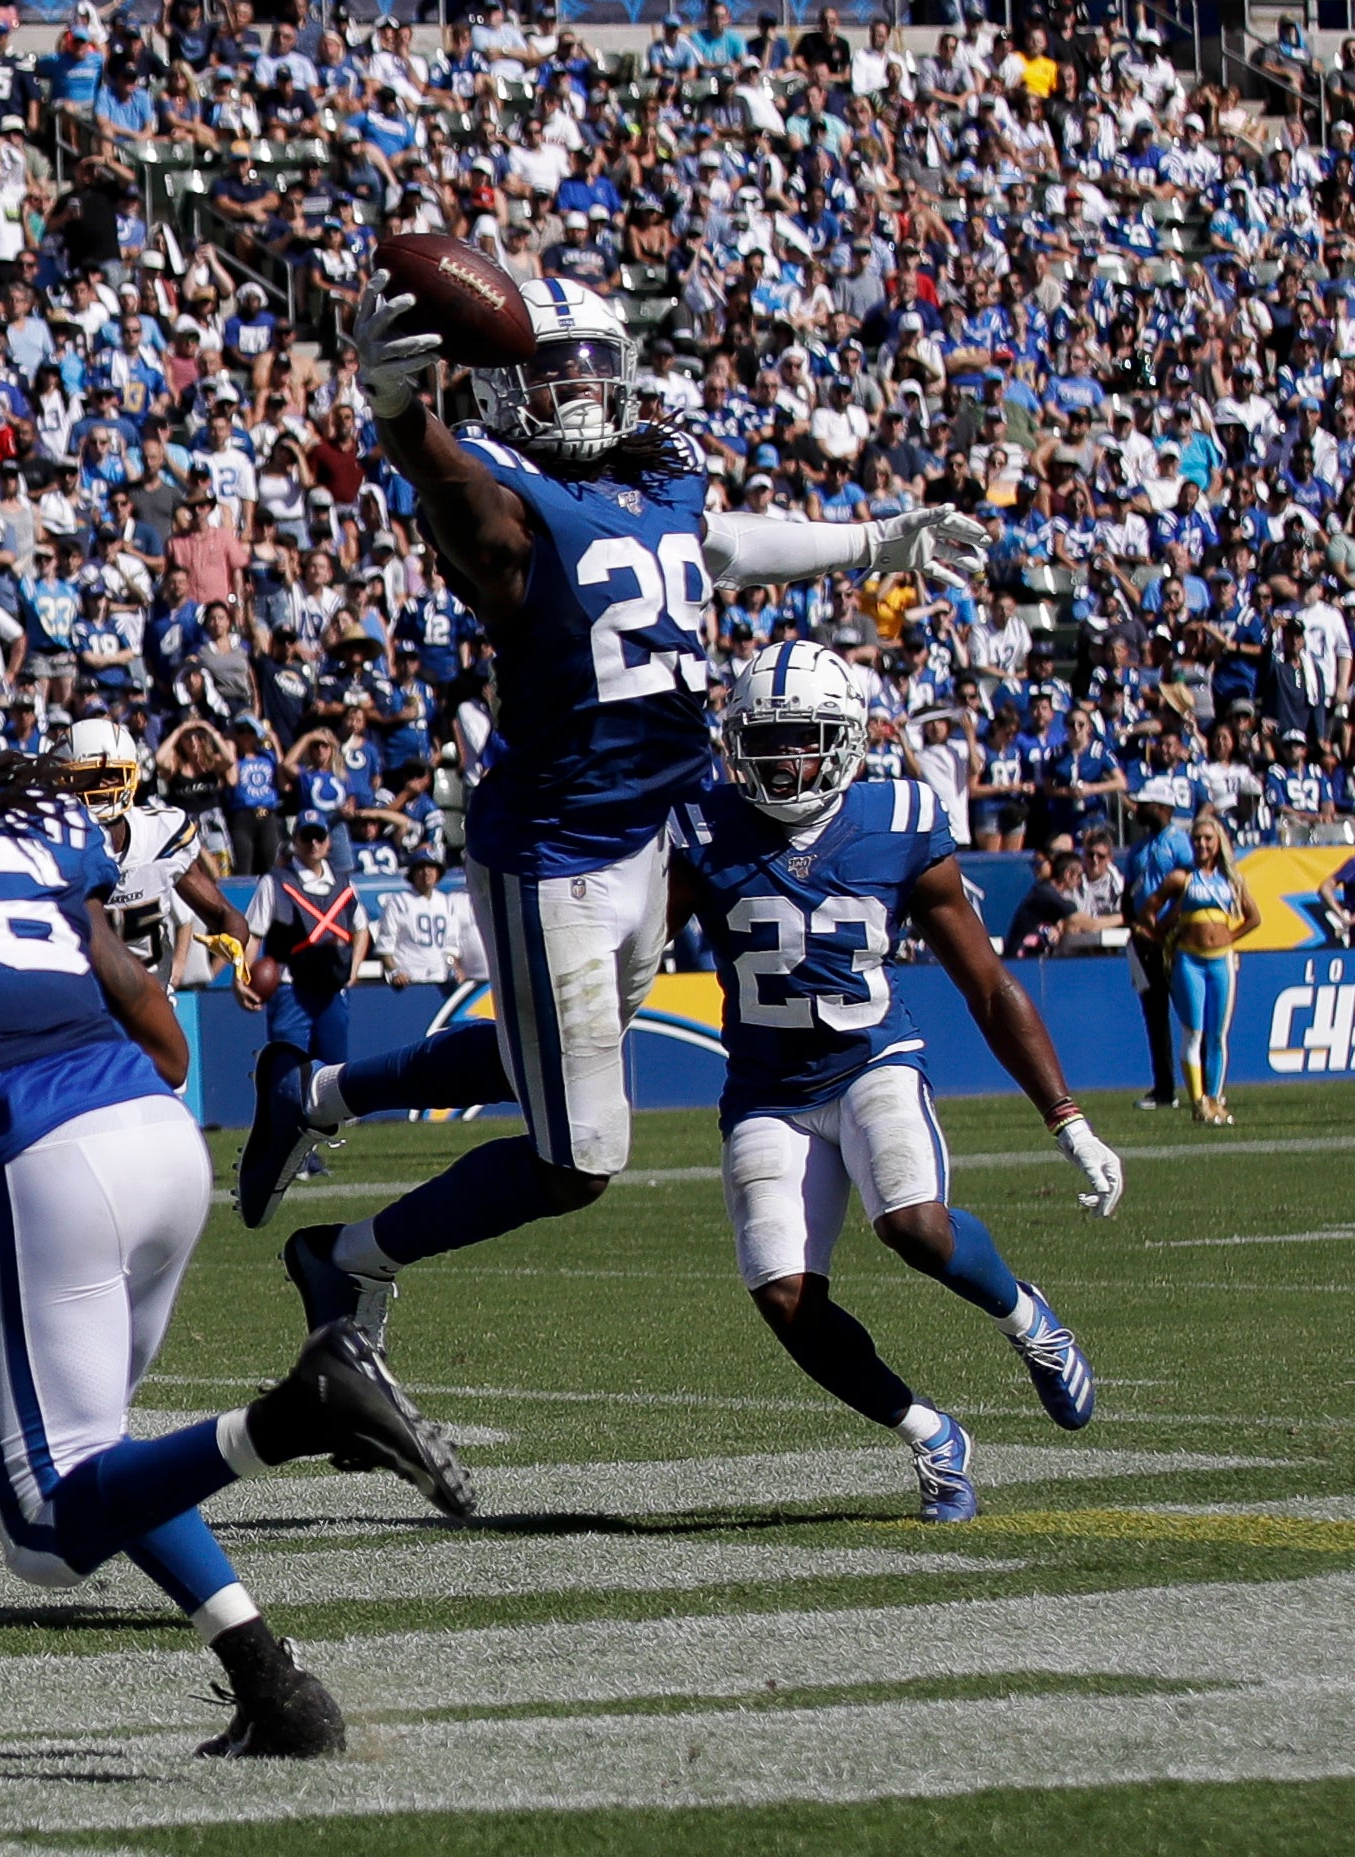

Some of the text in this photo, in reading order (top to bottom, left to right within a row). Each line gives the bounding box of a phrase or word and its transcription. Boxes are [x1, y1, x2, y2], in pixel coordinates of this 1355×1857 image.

[104, 896, 171, 970] 5
[417, 914, 447, 948] 98
[725, 896, 891, 1032] 23
[1268, 984, 1355, 1074] CH
